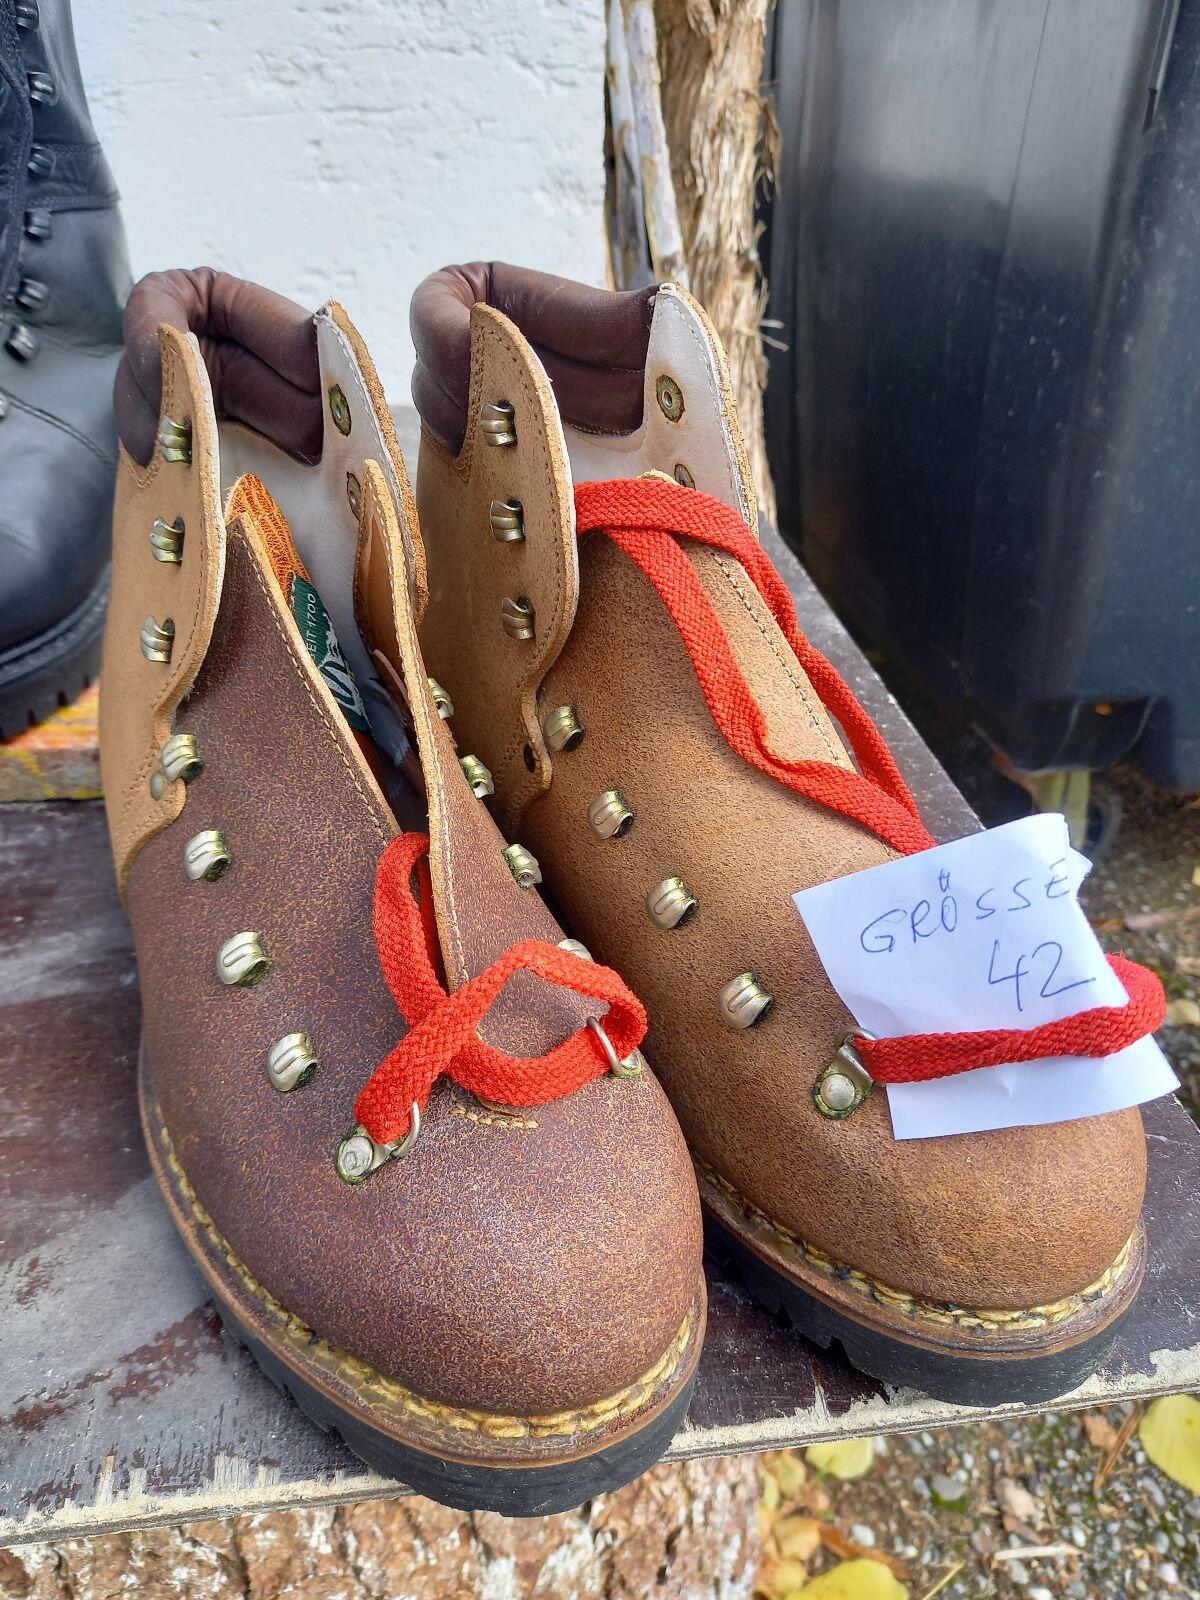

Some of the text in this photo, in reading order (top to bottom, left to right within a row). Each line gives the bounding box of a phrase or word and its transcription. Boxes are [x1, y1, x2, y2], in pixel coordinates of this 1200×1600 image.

[307, 593, 317, 628] 1700
[860, 858, 1070, 953] GRÖSSE
[988, 940, 1096, 1012] 42
